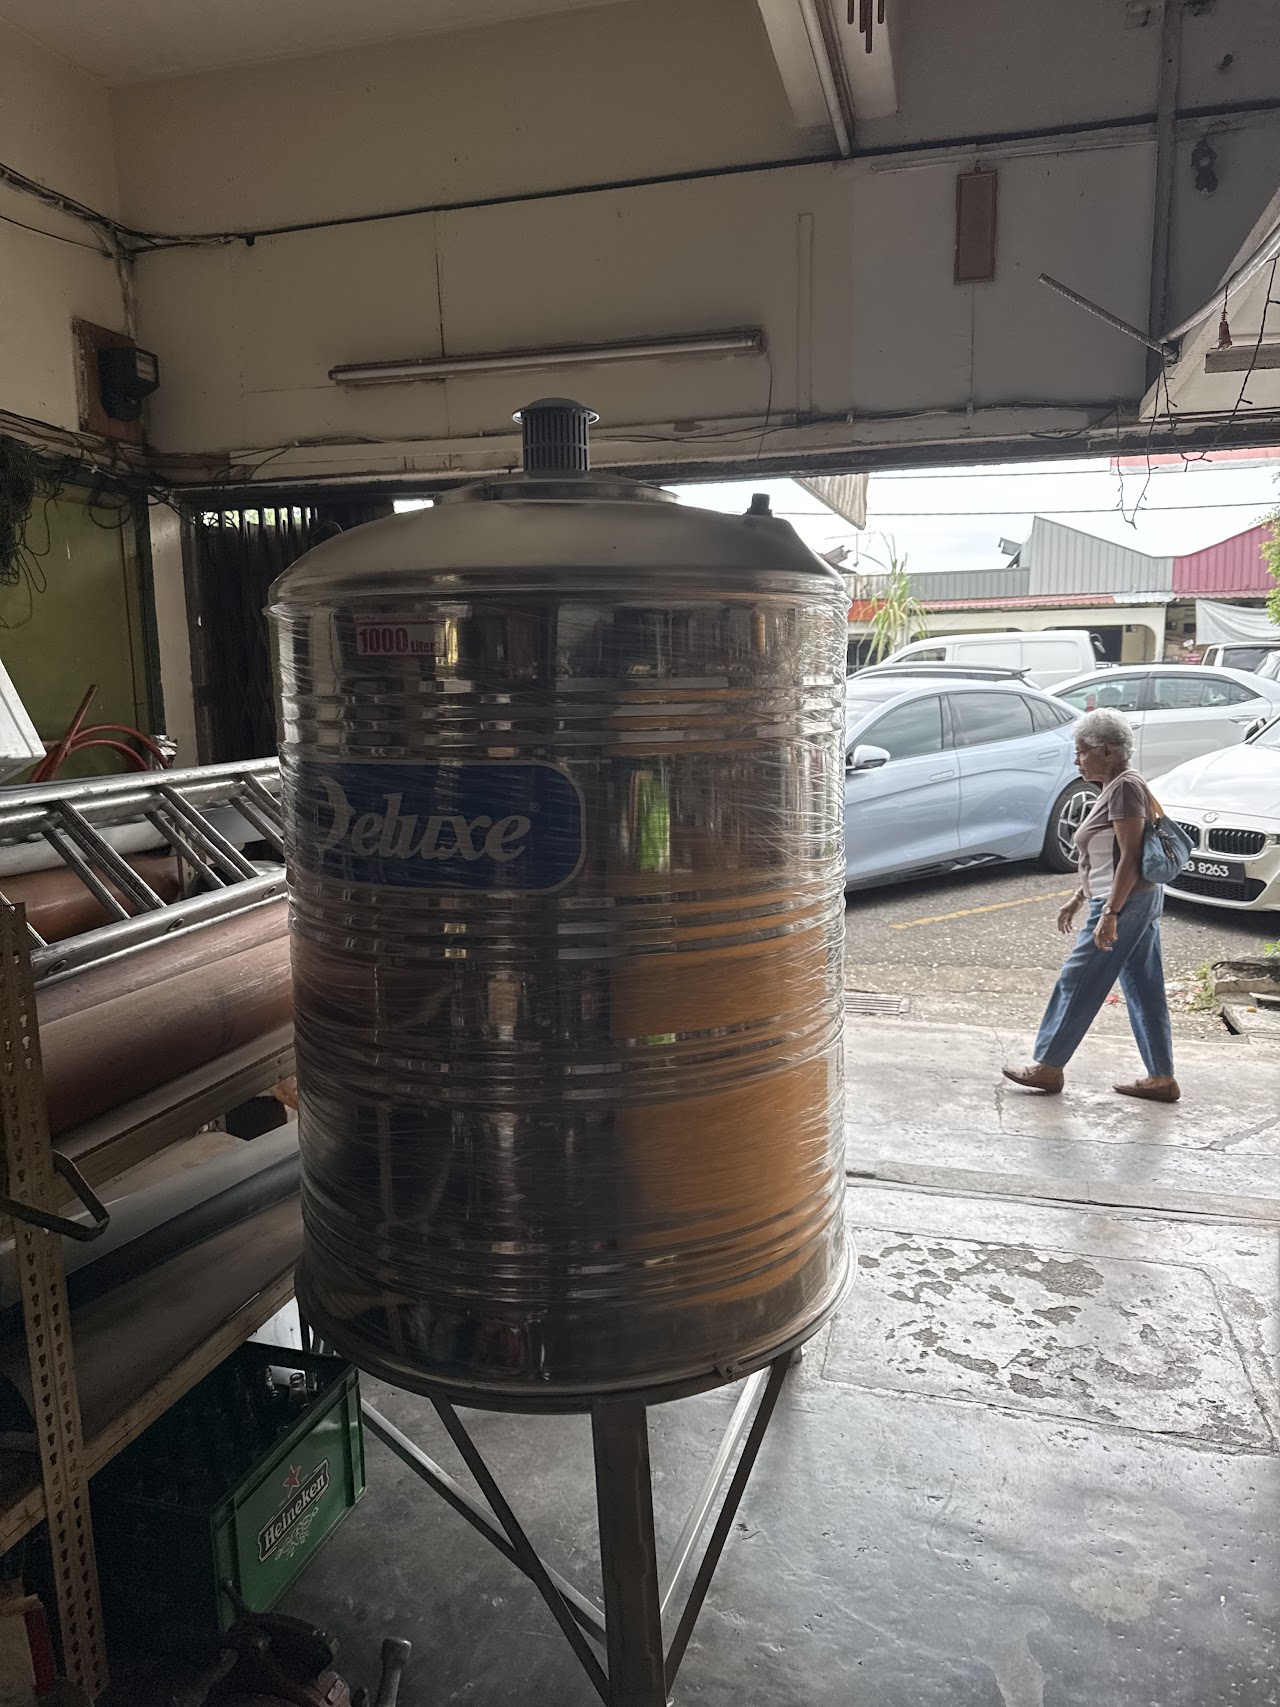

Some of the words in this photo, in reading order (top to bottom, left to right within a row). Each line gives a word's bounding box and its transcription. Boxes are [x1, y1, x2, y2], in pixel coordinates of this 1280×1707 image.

[359, 627, 408, 653] 1000
[312, 775, 531, 862] Deluxe
[1197, 862, 1229, 877] 8263
[264, 1474, 325, 1551] Heineken
